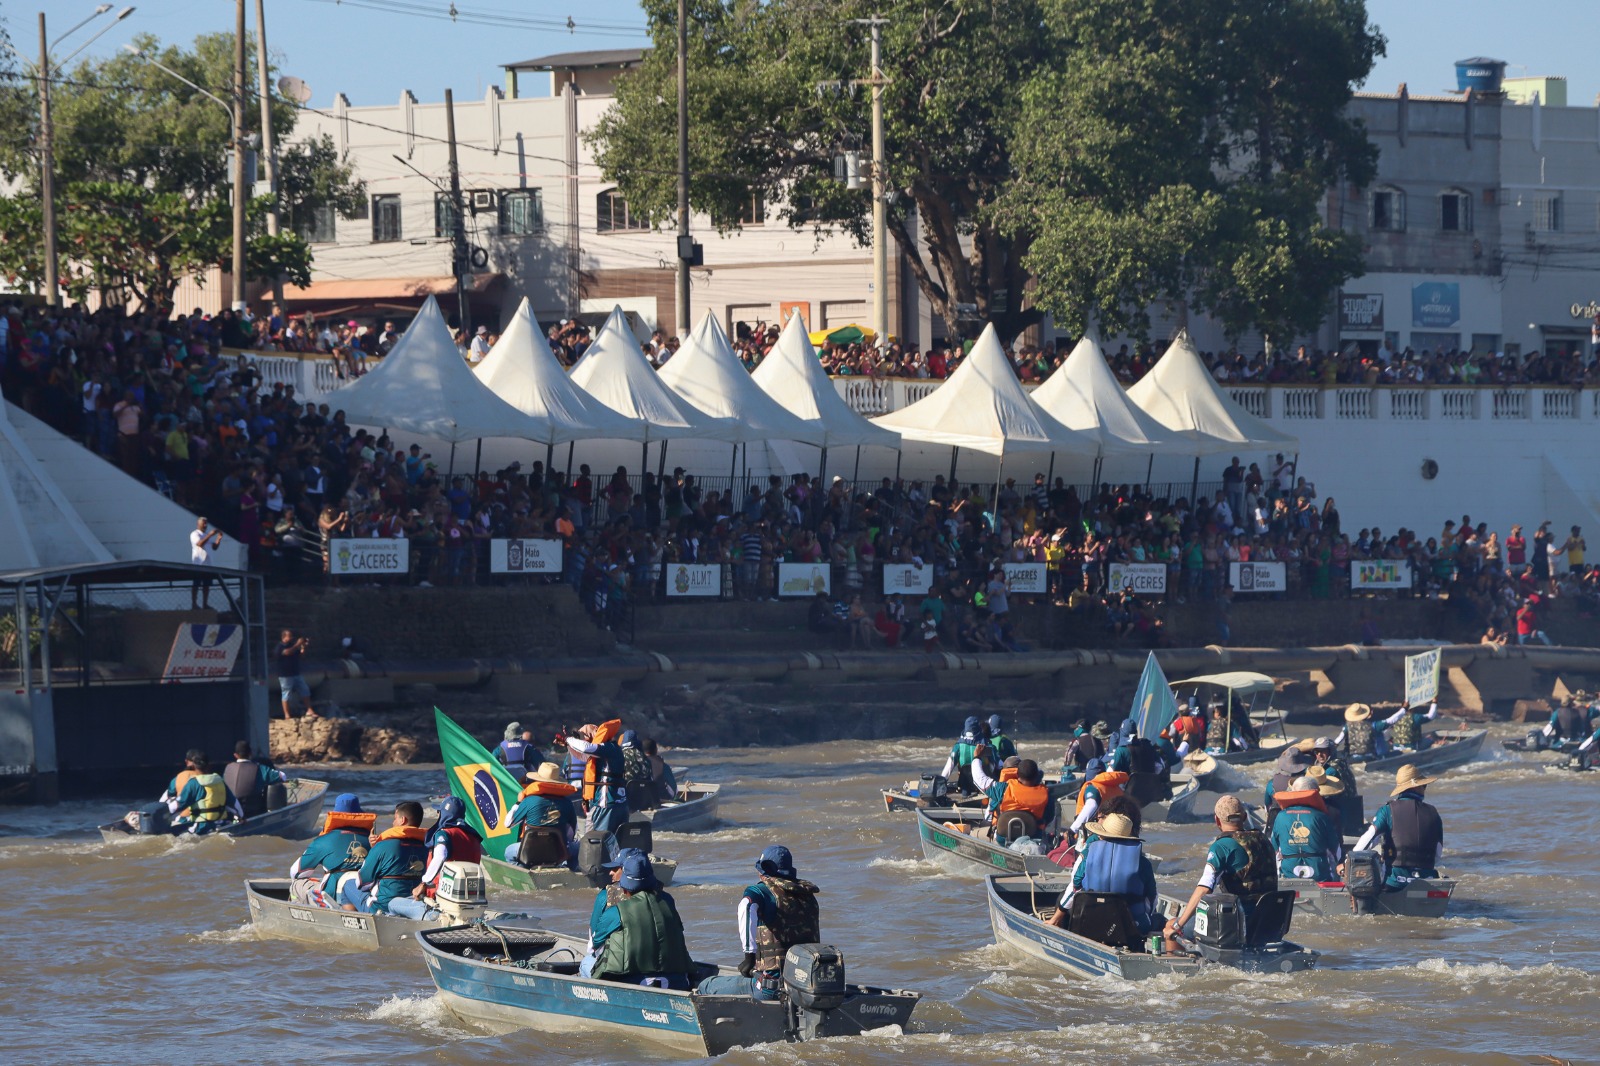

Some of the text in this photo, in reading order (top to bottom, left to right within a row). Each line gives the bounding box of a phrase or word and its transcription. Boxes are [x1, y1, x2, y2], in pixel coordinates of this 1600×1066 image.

[1343, 298, 1374, 312] STUDIO
[525, 548, 540, 557] Mato
[352, 551, 399, 569] CÁCERES
[525, 558, 545, 568] Grosso
[691, 570, 711, 585] ALMT
[1256, 570, 1270, 578] Mato
[1122, 573, 1163, 589] CÁCERES
[1256, 579, 1275, 588] Grosso
[194, 649, 226, 659] BATERIA
[171, 666, 194, 675] ACIMA
[195, 666, 207, 675] DE
[820, 965, 836, 978] 15
[669, 999, 694, 1016] Fishing
[860, 1003, 898, 1016] BUNITÃO
